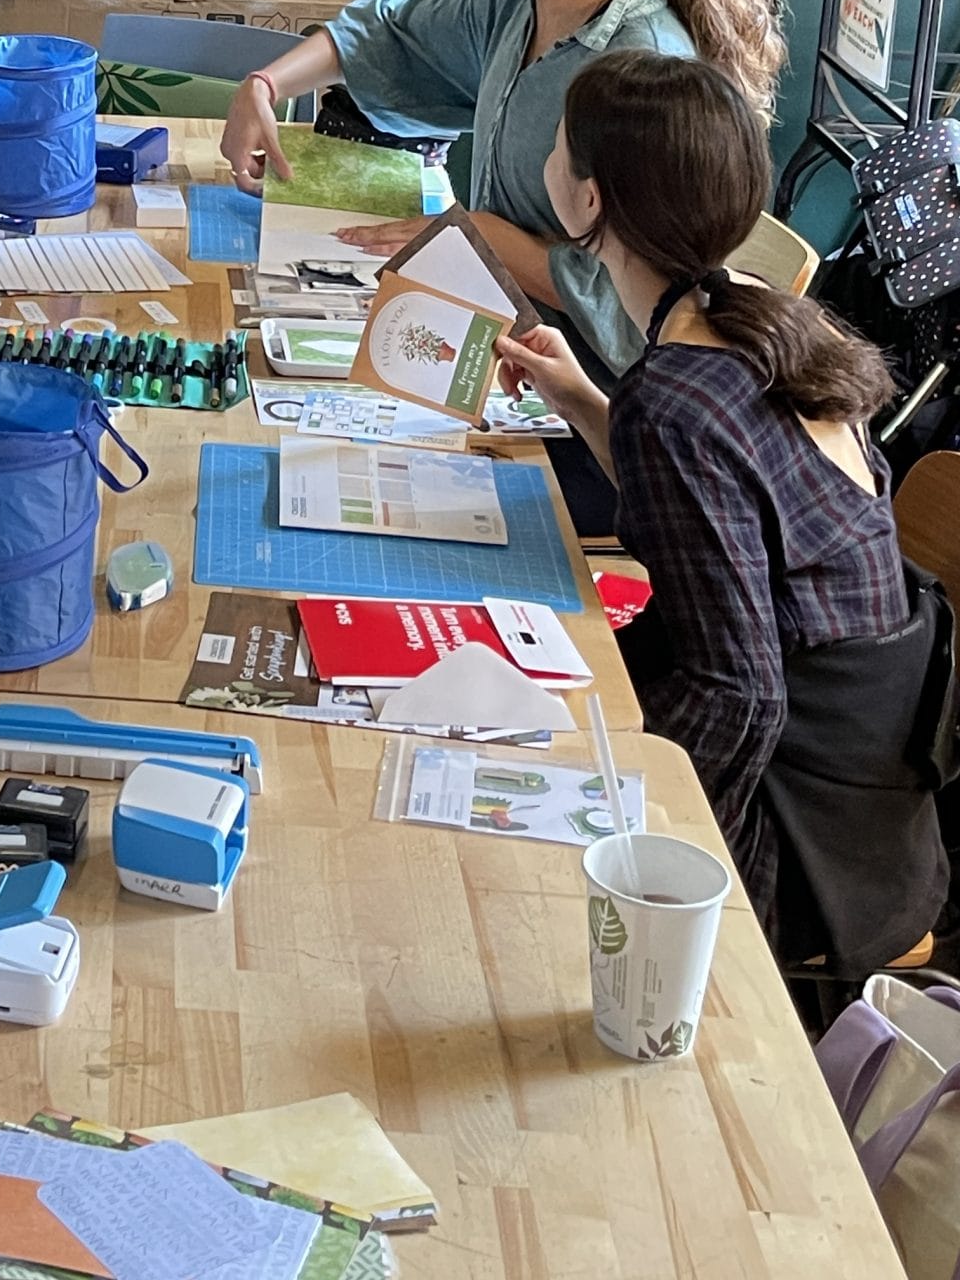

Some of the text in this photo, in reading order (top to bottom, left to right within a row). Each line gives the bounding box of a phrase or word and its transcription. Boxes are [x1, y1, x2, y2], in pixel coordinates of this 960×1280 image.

[382, 327, 396, 360] LOVE
[390, 302, 409, 324] YOU
[458, 342, 478, 385] from my
[462, 380, 476, 405] head
[417, 606, 448, 642] moment
